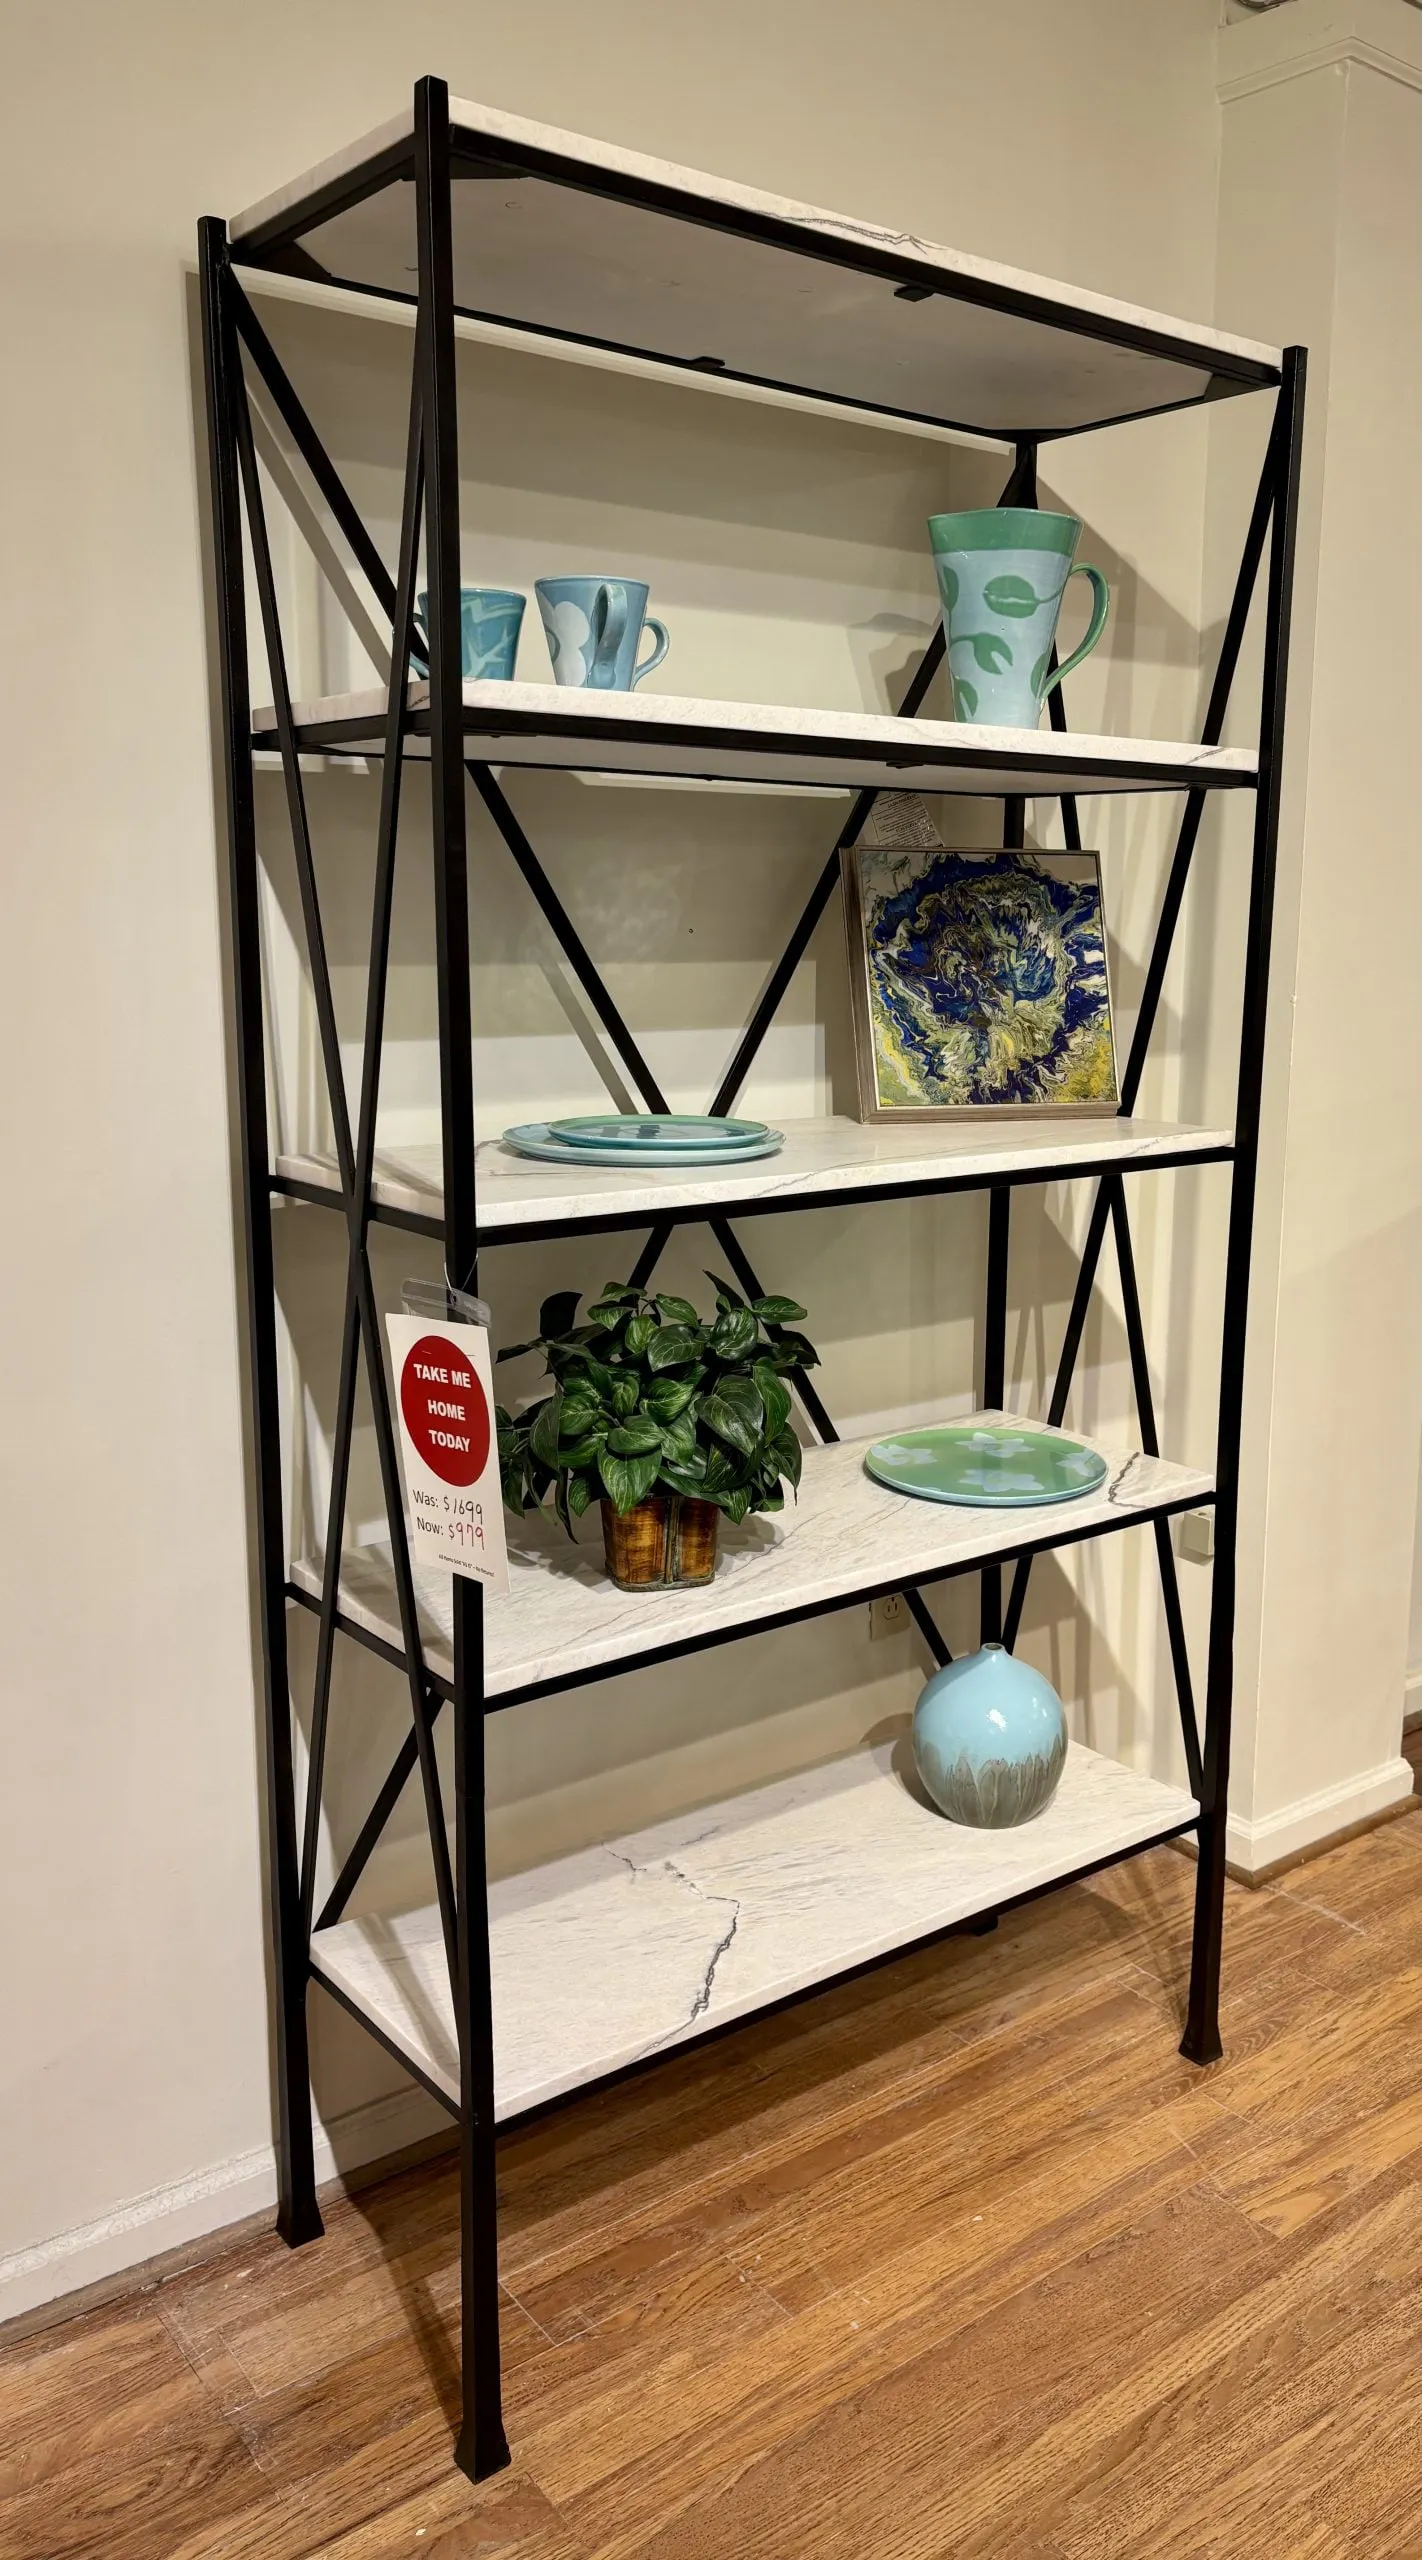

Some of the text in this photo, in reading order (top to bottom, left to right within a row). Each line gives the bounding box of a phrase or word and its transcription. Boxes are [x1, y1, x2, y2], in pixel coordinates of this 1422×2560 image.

[413, 1363, 471, 1388] TAKE ME
[427, 1399, 466, 1421] HOME
[428, 1429, 470, 1453] TODAY
[412, 1489, 438, 1508] Was:
[416, 1516, 485, 1551] Now: $979
